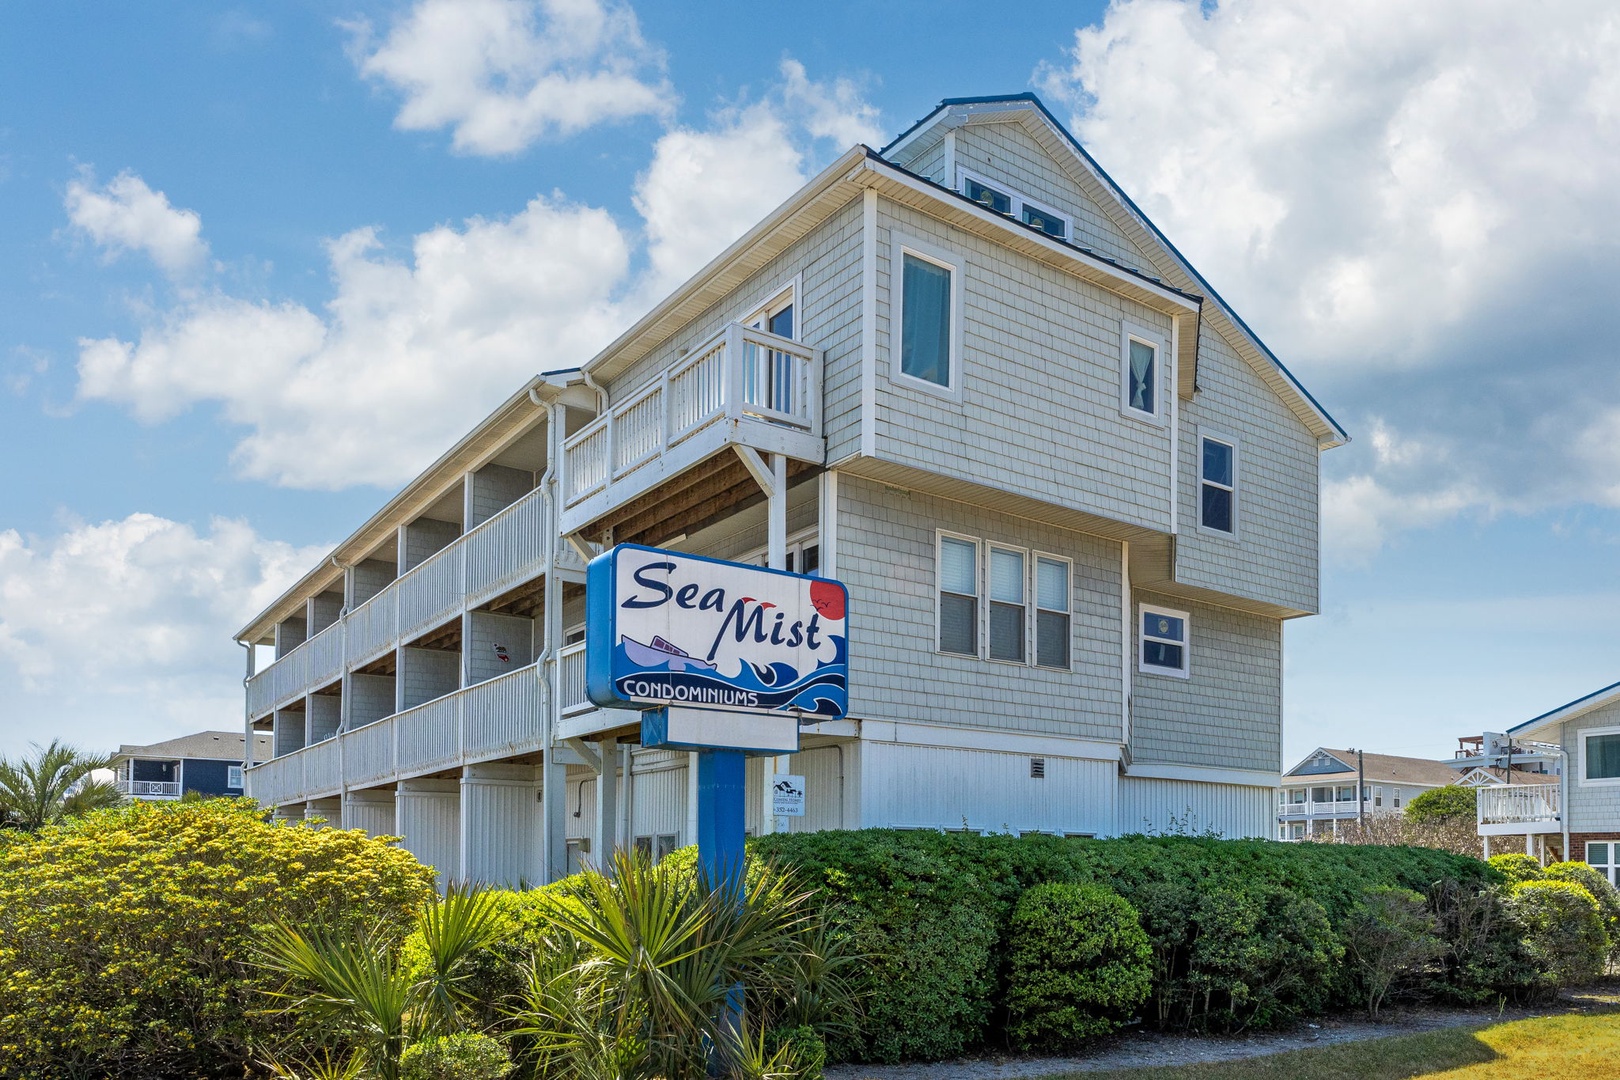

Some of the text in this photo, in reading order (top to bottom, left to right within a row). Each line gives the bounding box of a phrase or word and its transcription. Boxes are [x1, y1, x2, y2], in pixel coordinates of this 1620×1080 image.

[621, 562, 822, 661] Sea Mist
[623, 680, 759, 707] CONDOMINIUMS
